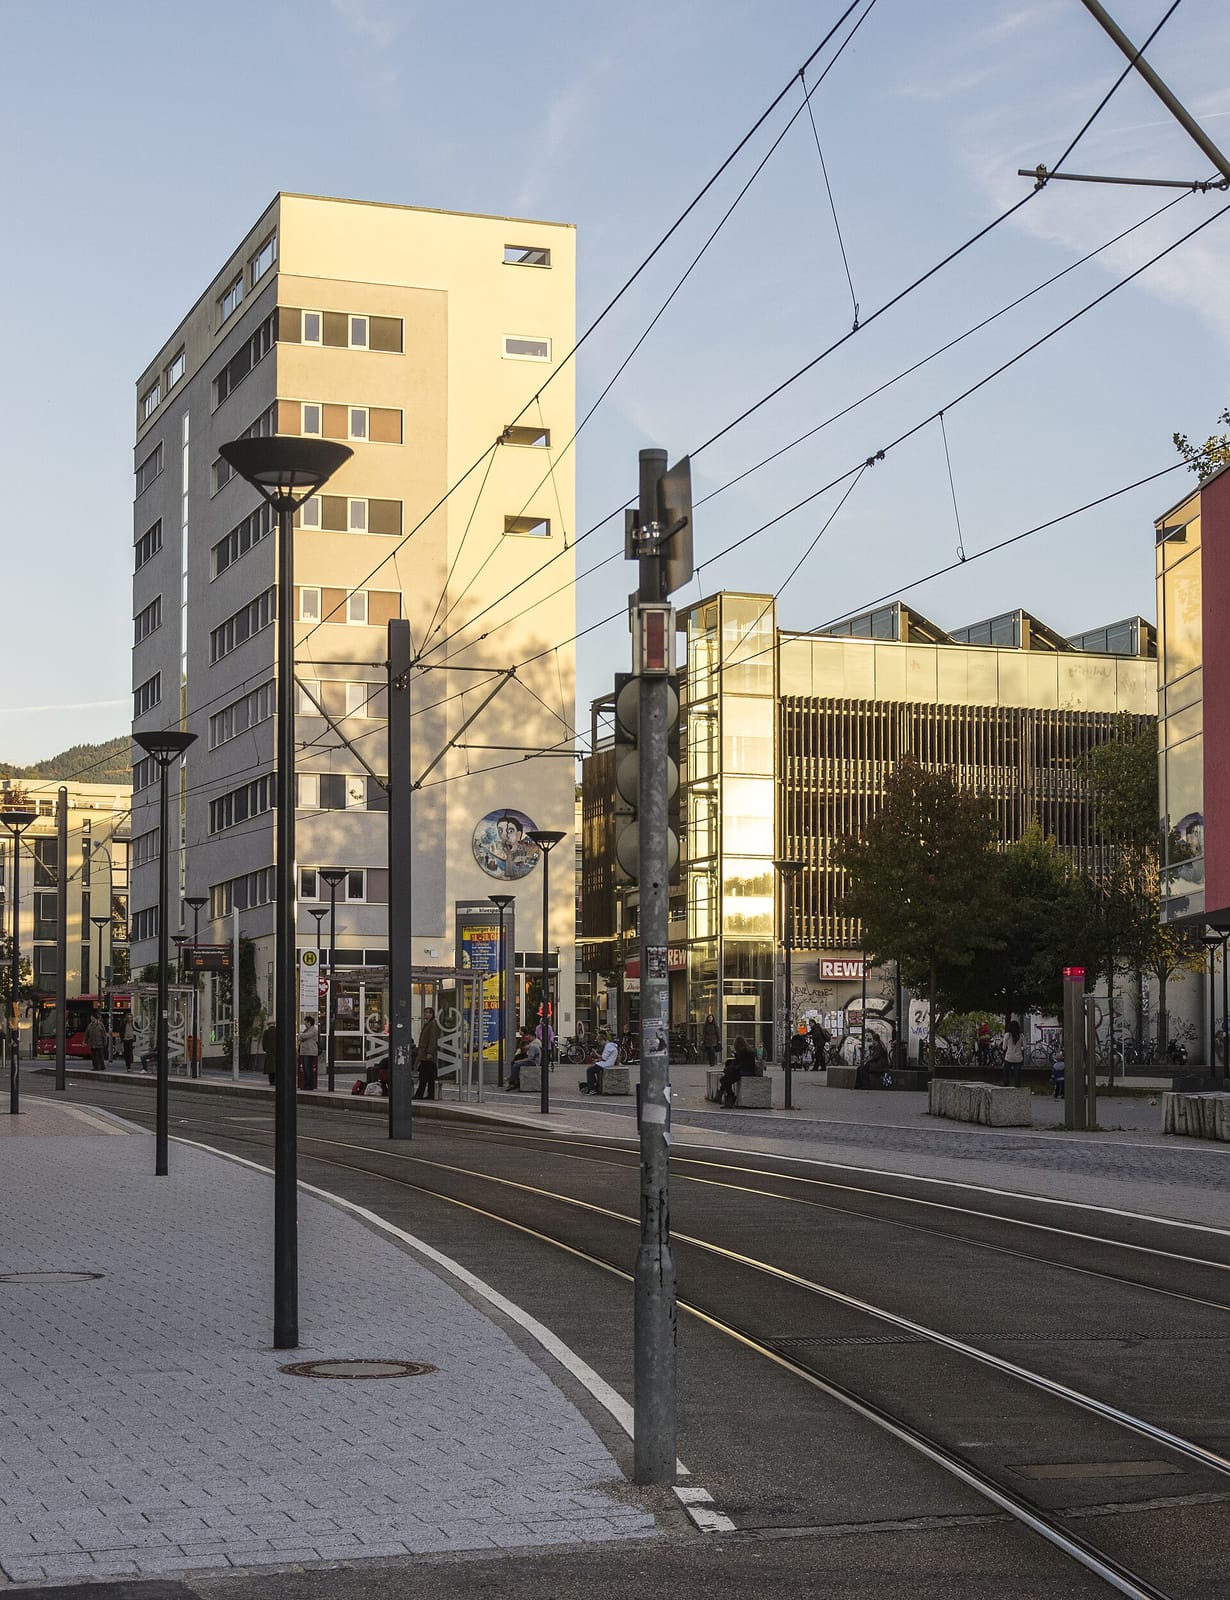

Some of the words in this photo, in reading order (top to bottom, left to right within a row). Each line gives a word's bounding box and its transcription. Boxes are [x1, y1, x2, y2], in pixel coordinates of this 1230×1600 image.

[306, 954, 313, 963] H
[668, 949, 686, 966] REW
[822, 961, 868, 977] REWE
[437, 1006, 462, 1077] VAG
